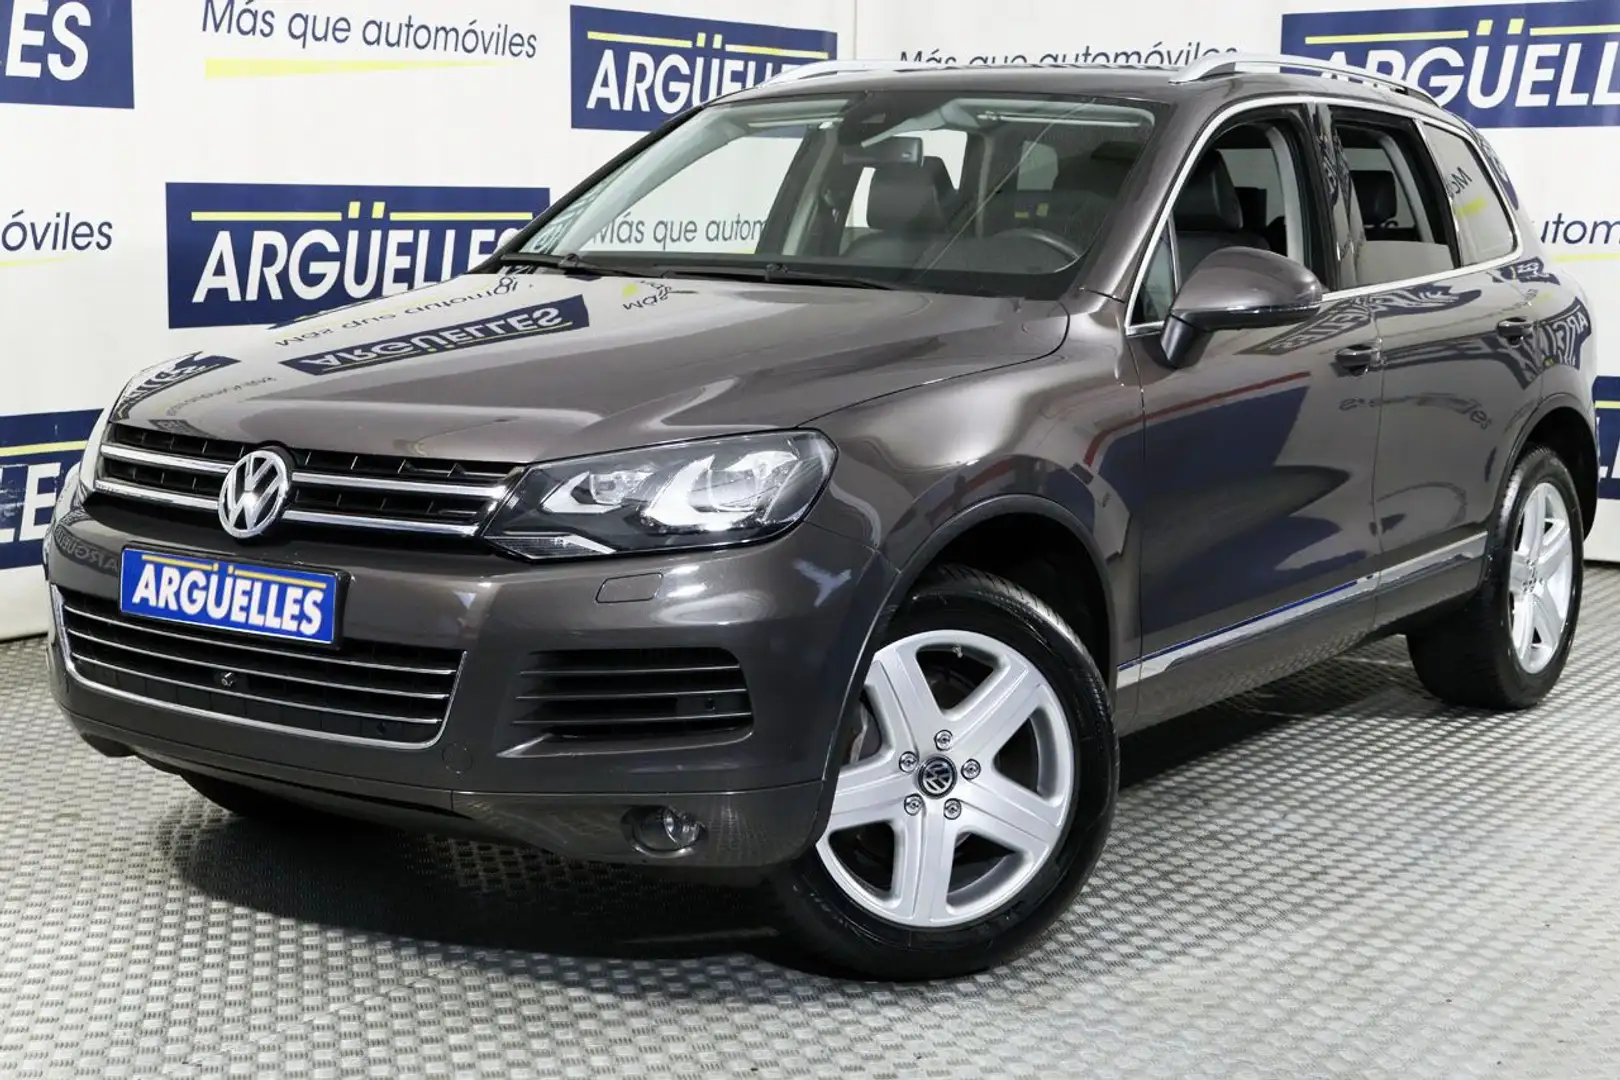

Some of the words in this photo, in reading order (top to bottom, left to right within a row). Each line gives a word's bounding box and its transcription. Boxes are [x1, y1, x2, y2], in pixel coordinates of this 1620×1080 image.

[201, 0, 276, 38] Más
[287, 12, 352, 49] que
[362, 15, 538, 58] automóviles
[586, 32, 803, 114] ARGÜE
[1, 208, 113, 252] óviles
[191, 201, 522, 303] ARGÜELLE
[653, 219, 698, 251] que
[132, 562, 323, 636] ARGÜELLES
